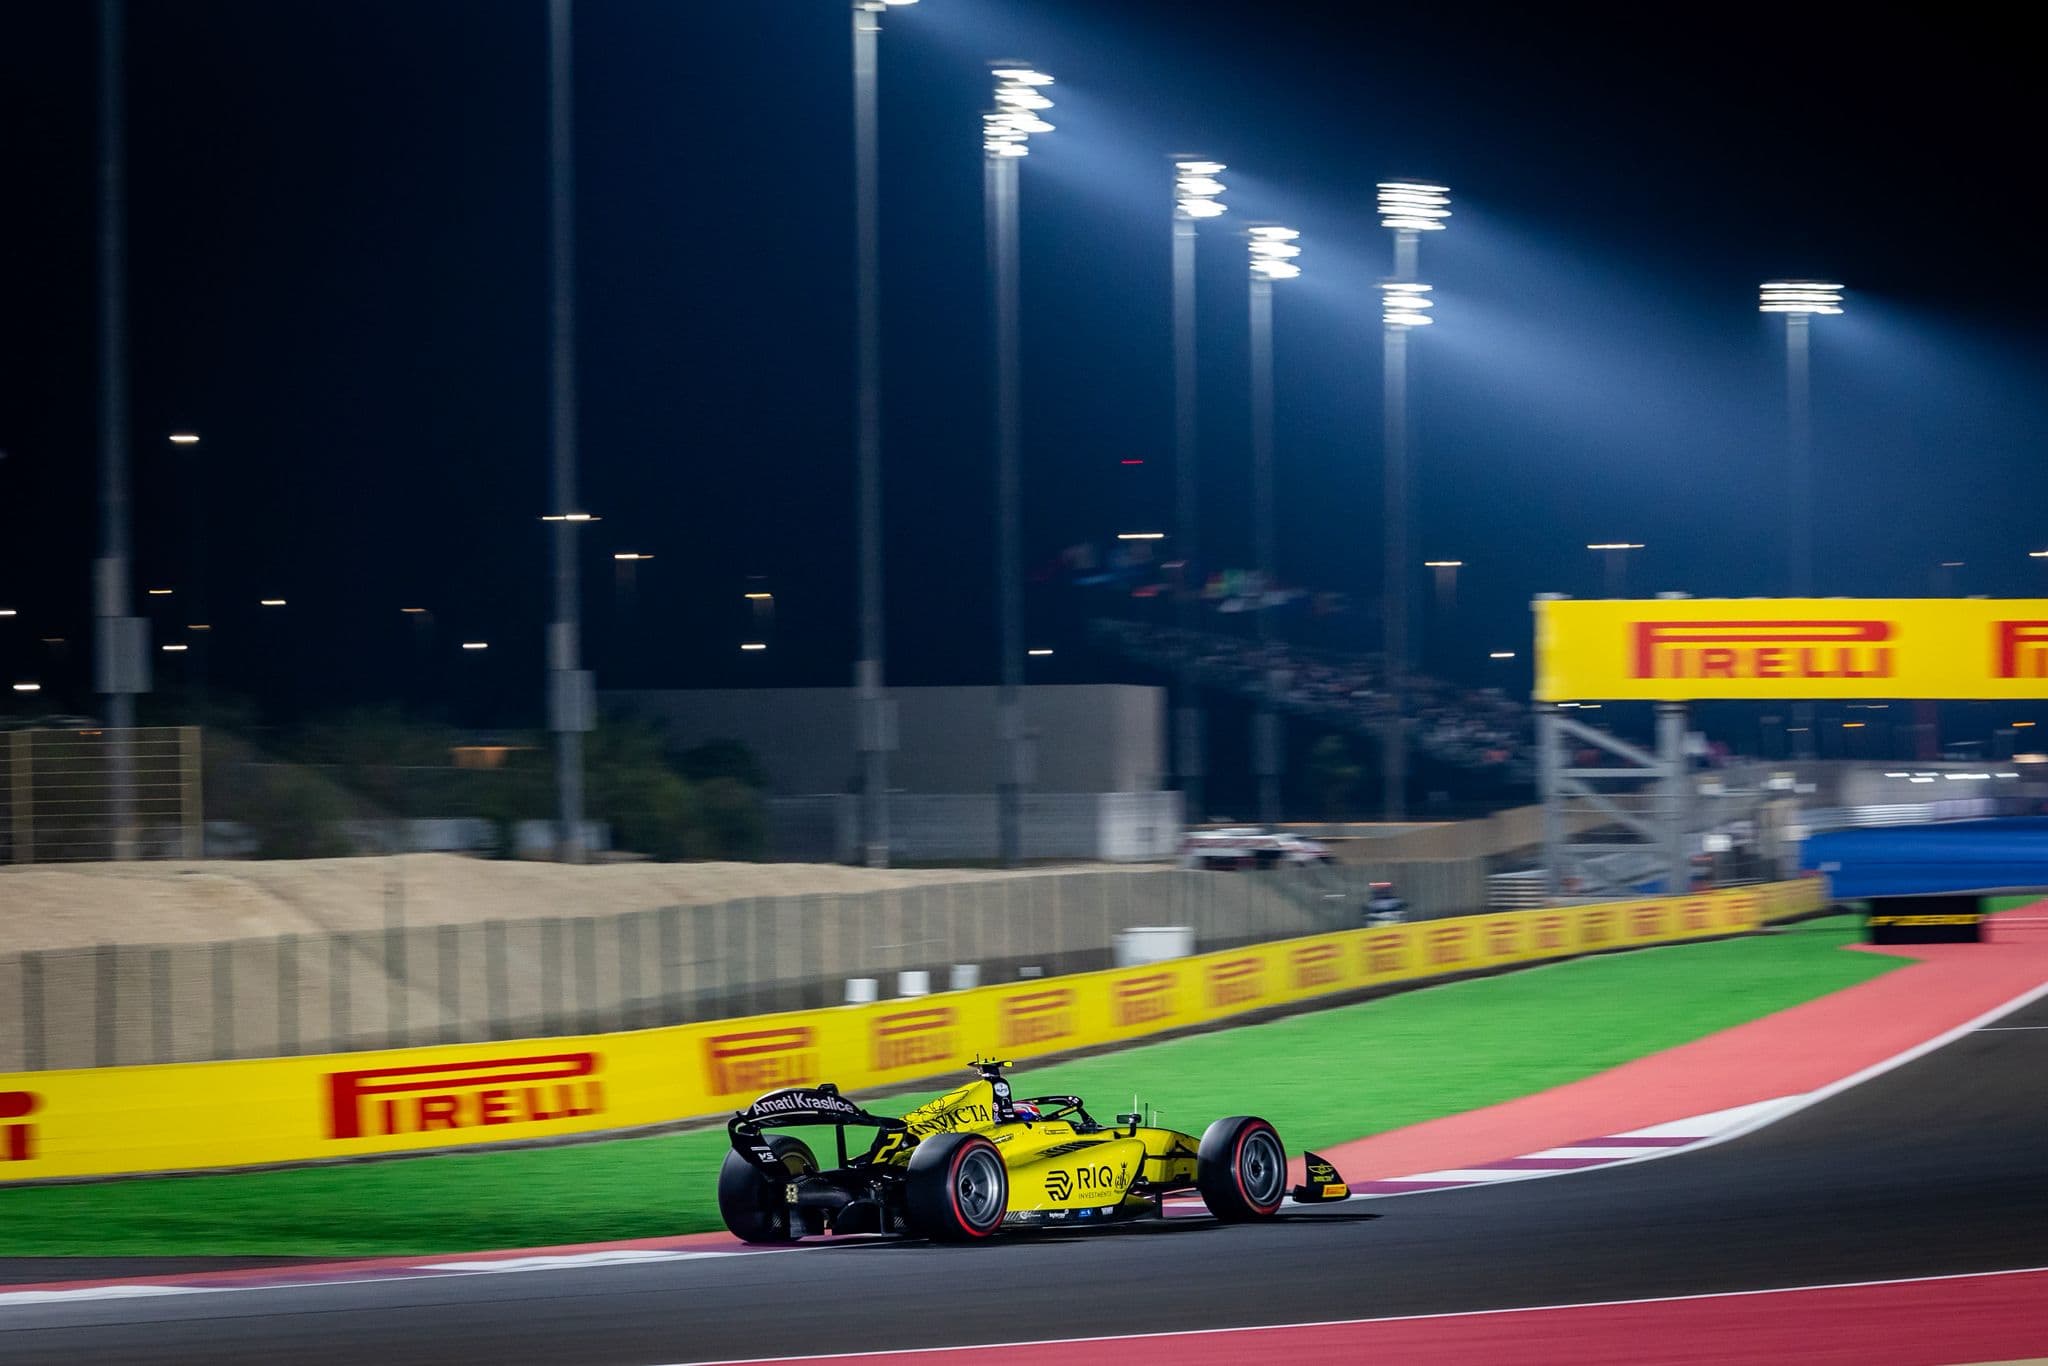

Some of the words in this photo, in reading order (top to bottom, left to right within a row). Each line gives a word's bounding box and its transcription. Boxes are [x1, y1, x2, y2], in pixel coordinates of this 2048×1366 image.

[1630, 620, 1898, 679] PIRELLI
[702, 1025, 817, 1096] PIRELLI
[324, 1051, 606, 1139] PIRELLI
[753, 1095, 796, 1115] Amati
[793, 1092, 855, 1114] Kraslice
[910, 1104, 990, 1135] INVICTA
[872, 1133, 904, 1165] 2
[1077, 1165, 1113, 1190] RIQ
